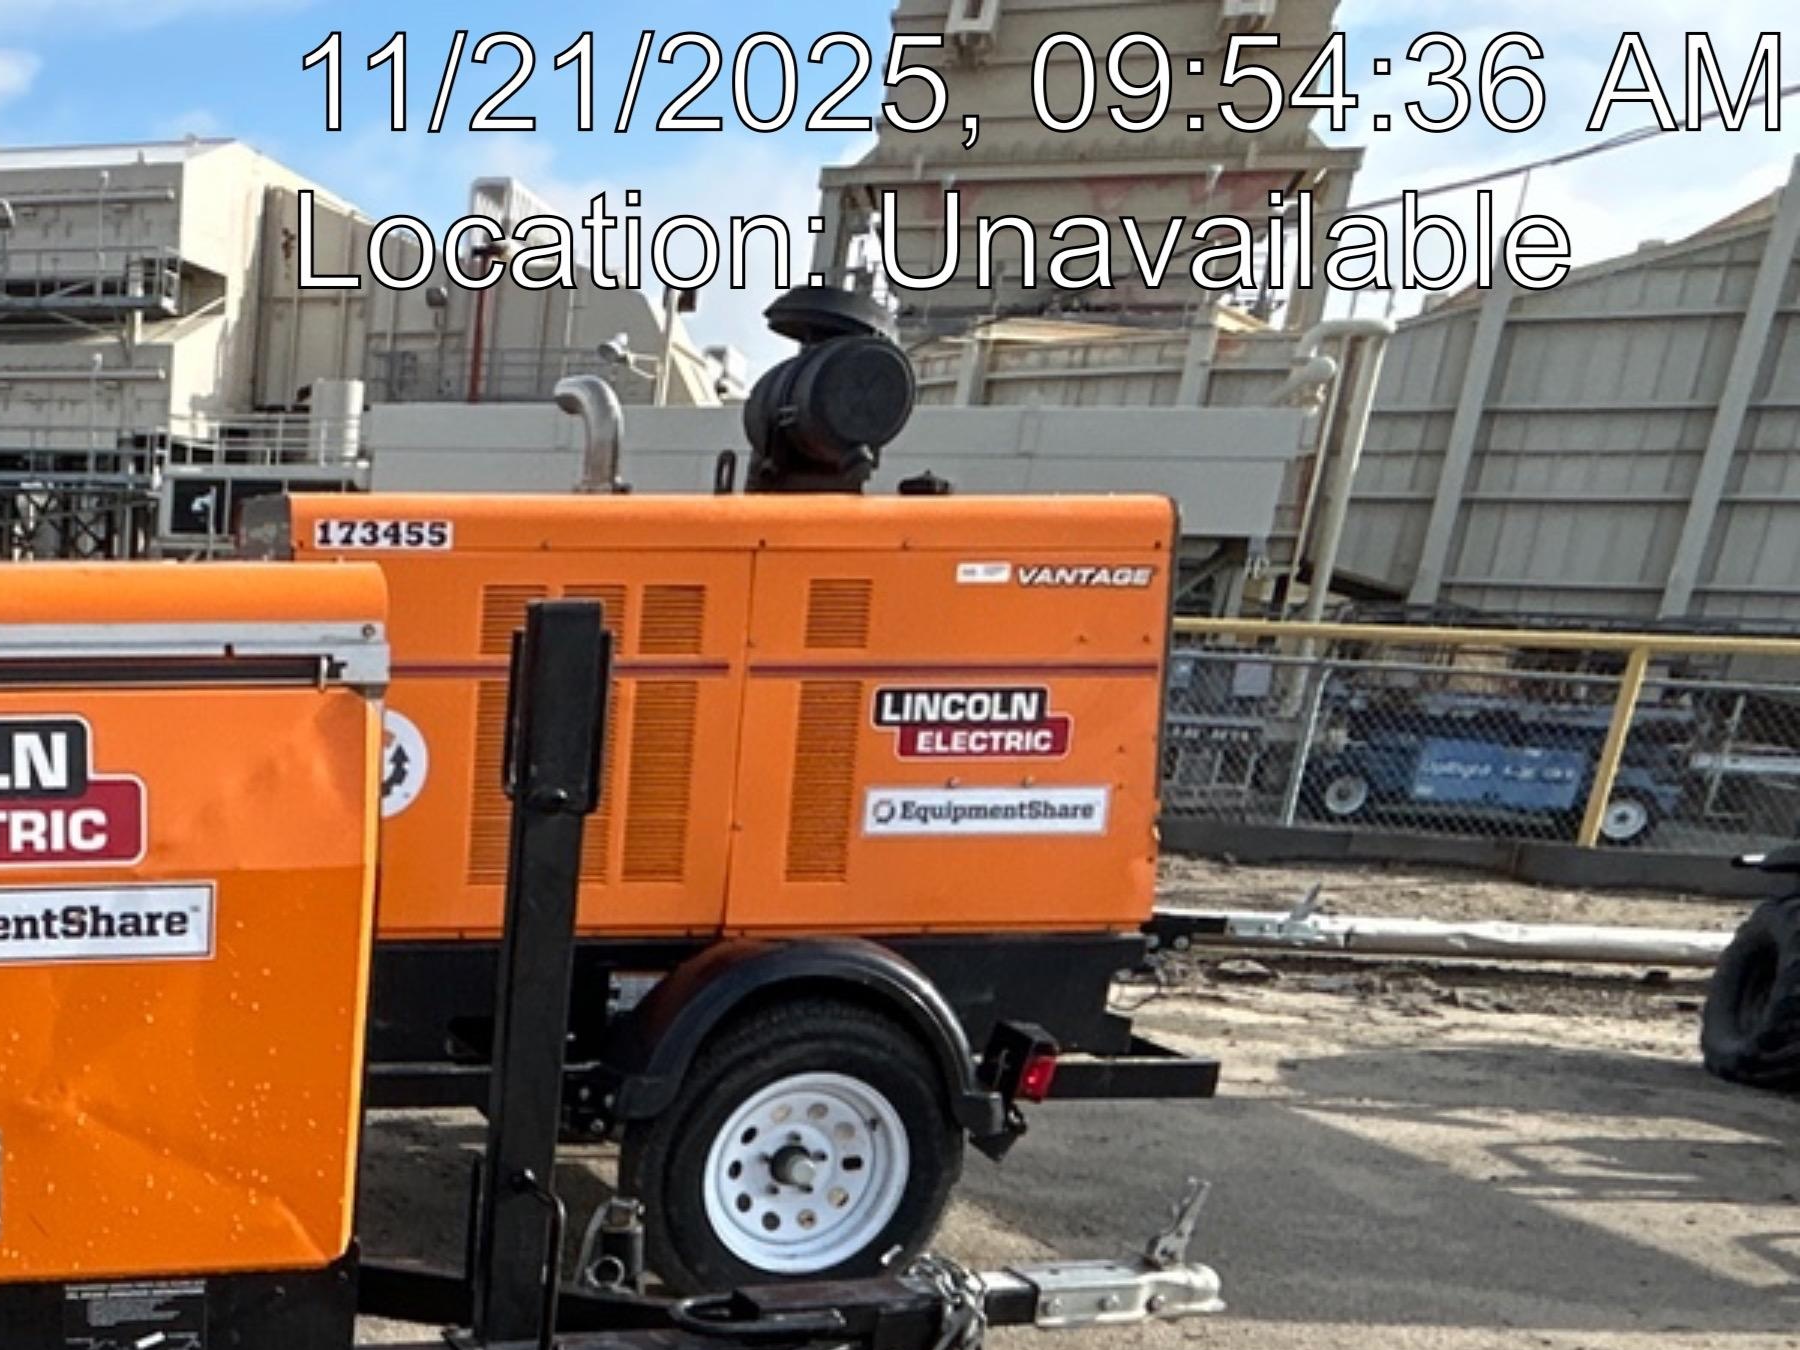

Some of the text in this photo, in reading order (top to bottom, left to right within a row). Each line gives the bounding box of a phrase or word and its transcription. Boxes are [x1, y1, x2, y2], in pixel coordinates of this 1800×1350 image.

[318, 520, 448, 546] 173455
[1018, 565, 1152, 587] VANTAGE
[881, 691, 1041, 722] LINCOLN
[916, 730, 1054, 753] ELECTRIC
[901, 799, 1095, 825] EquipmentShare
